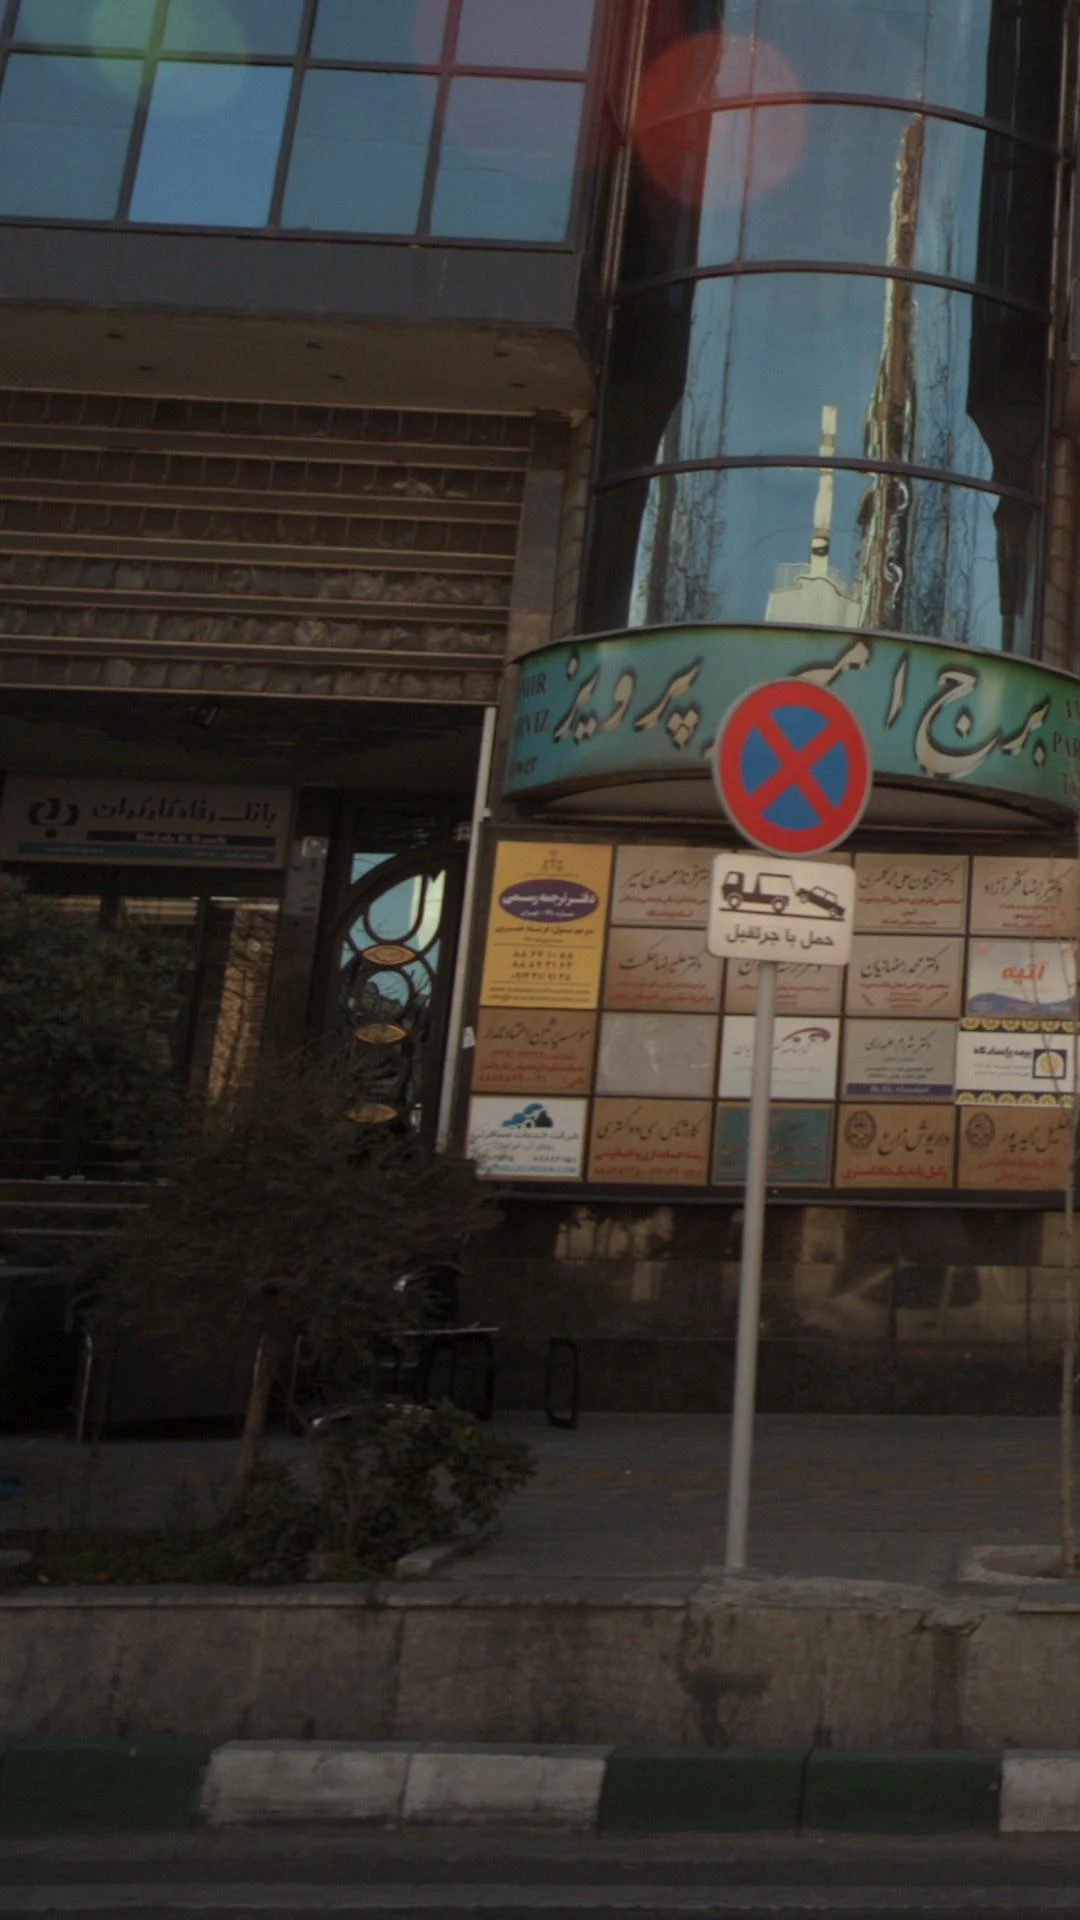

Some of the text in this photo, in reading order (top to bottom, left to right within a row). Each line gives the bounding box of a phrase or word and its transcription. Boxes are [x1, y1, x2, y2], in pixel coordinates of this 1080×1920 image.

[552, 648, 704, 750] پرویز
[914, 662, 1052, 781] برج
[92, 795, 277, 829] بانک رفاه کارگران
[501, 891, 597, 907] دفتر ترجمه رسمی
[725, 923, 835, 949] حمل با جرثقیل
